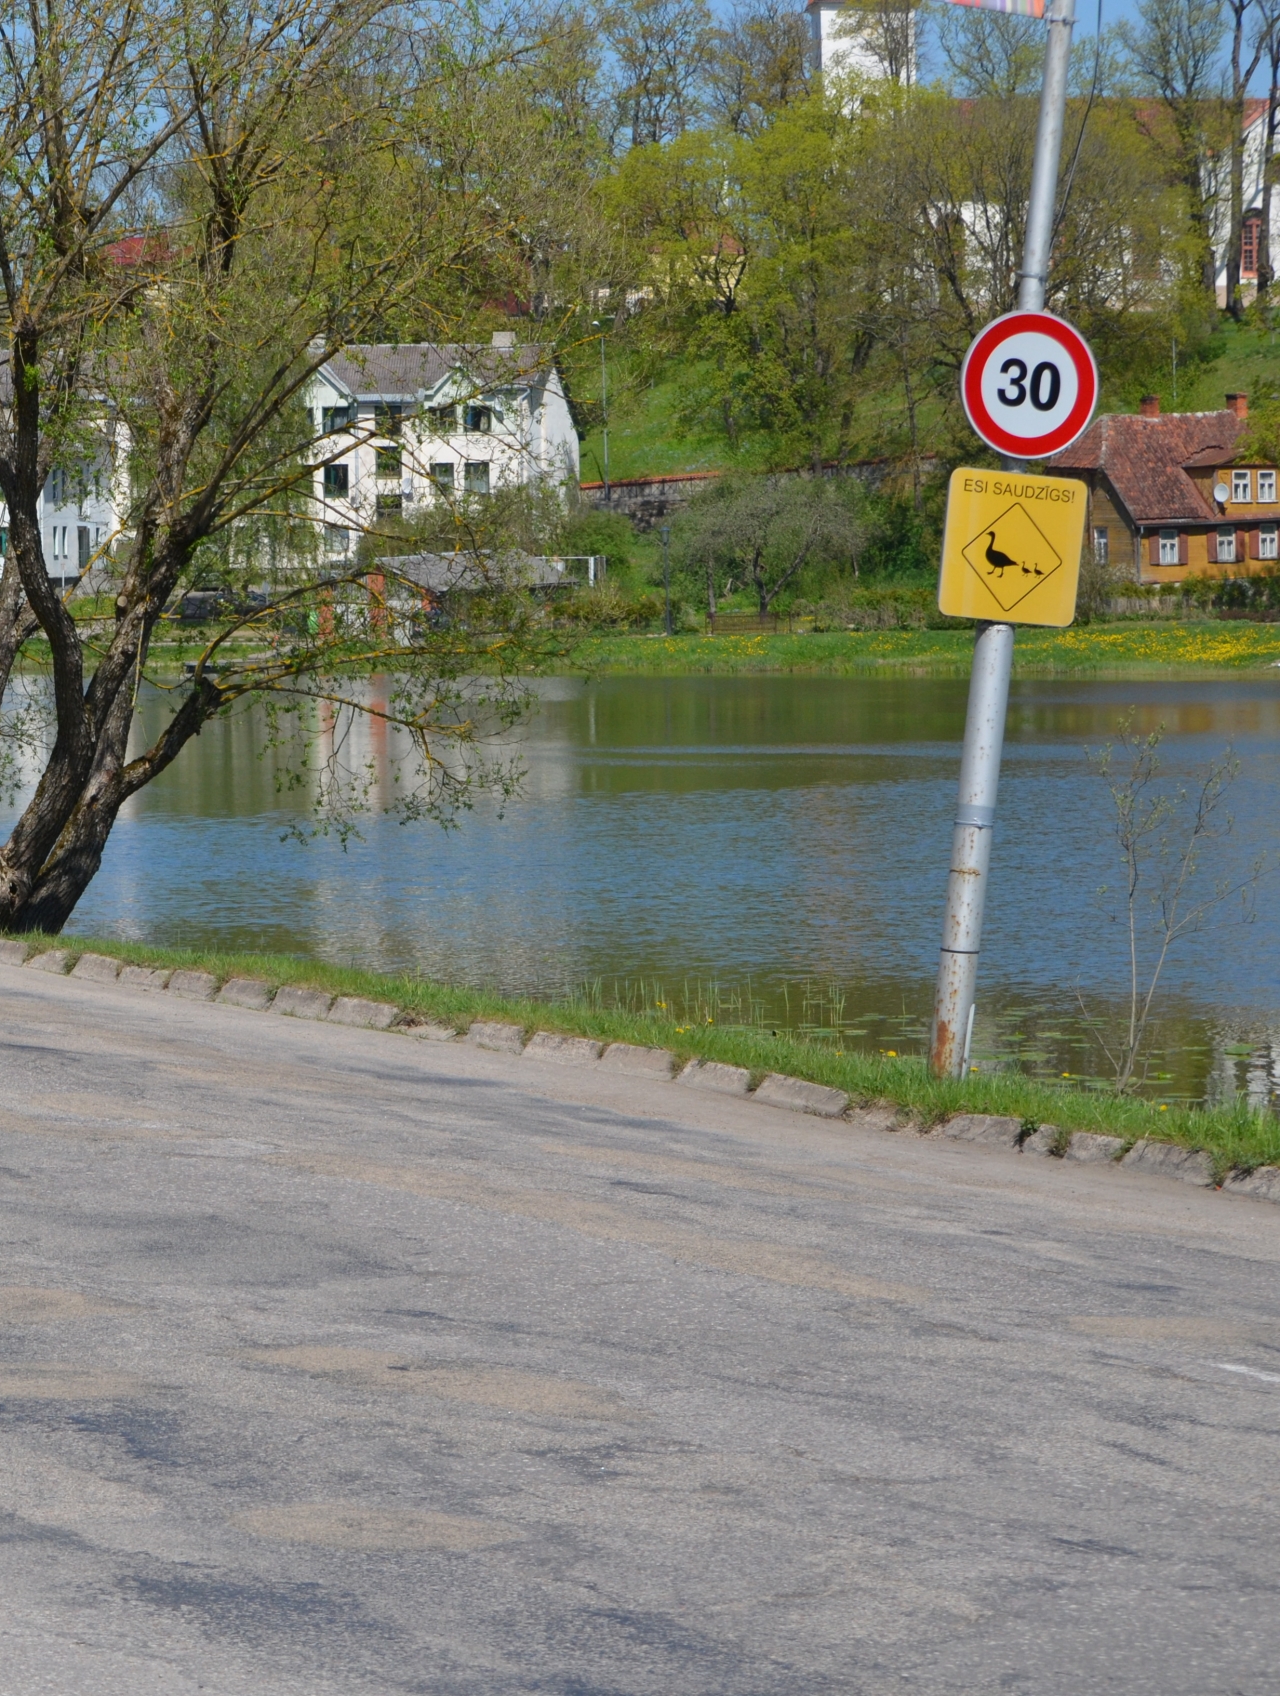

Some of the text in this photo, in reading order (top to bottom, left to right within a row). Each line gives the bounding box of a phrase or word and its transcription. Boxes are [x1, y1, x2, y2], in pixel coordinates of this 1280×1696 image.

[997, 358, 1061, 412] 30
[963, 478, 1076, 504] ESI SAUDZĪGS!
